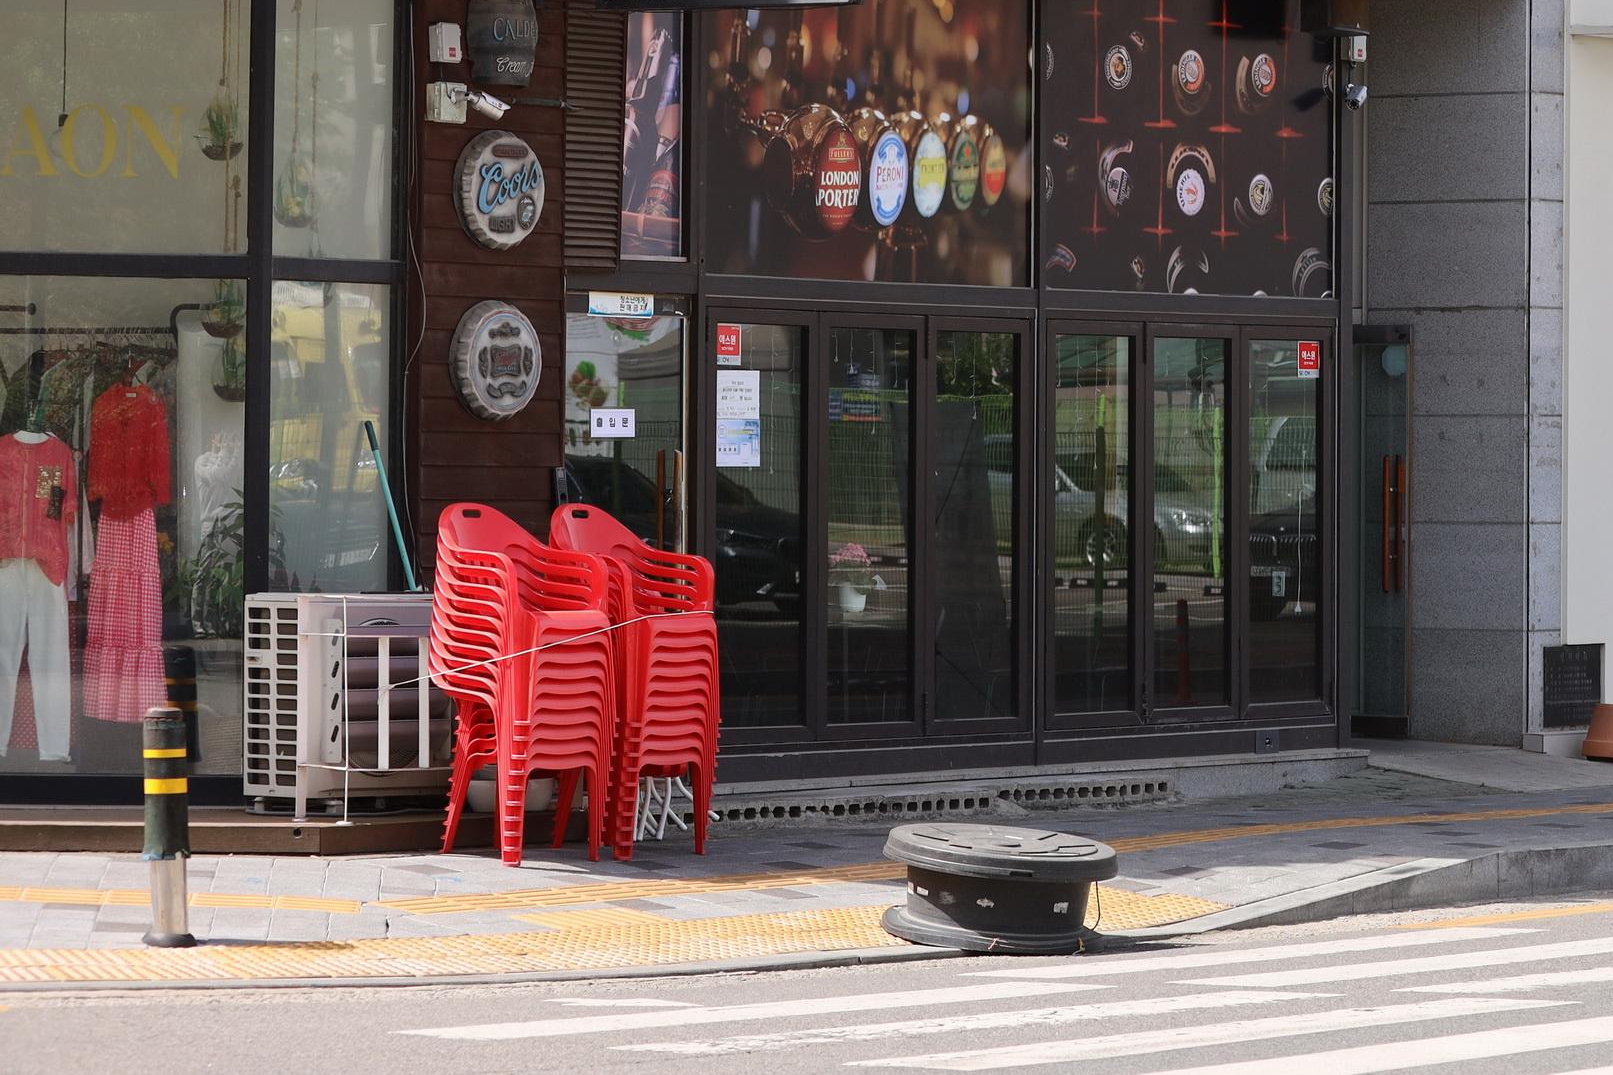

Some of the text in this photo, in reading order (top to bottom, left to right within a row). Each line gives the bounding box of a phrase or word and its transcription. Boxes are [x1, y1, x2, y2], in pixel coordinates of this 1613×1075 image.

[820, 170, 859, 186] LONDON
[876, 165, 905, 183] PERONI
[477, 159, 542, 214] Coors
[816, 188, 860, 209] PORTER
